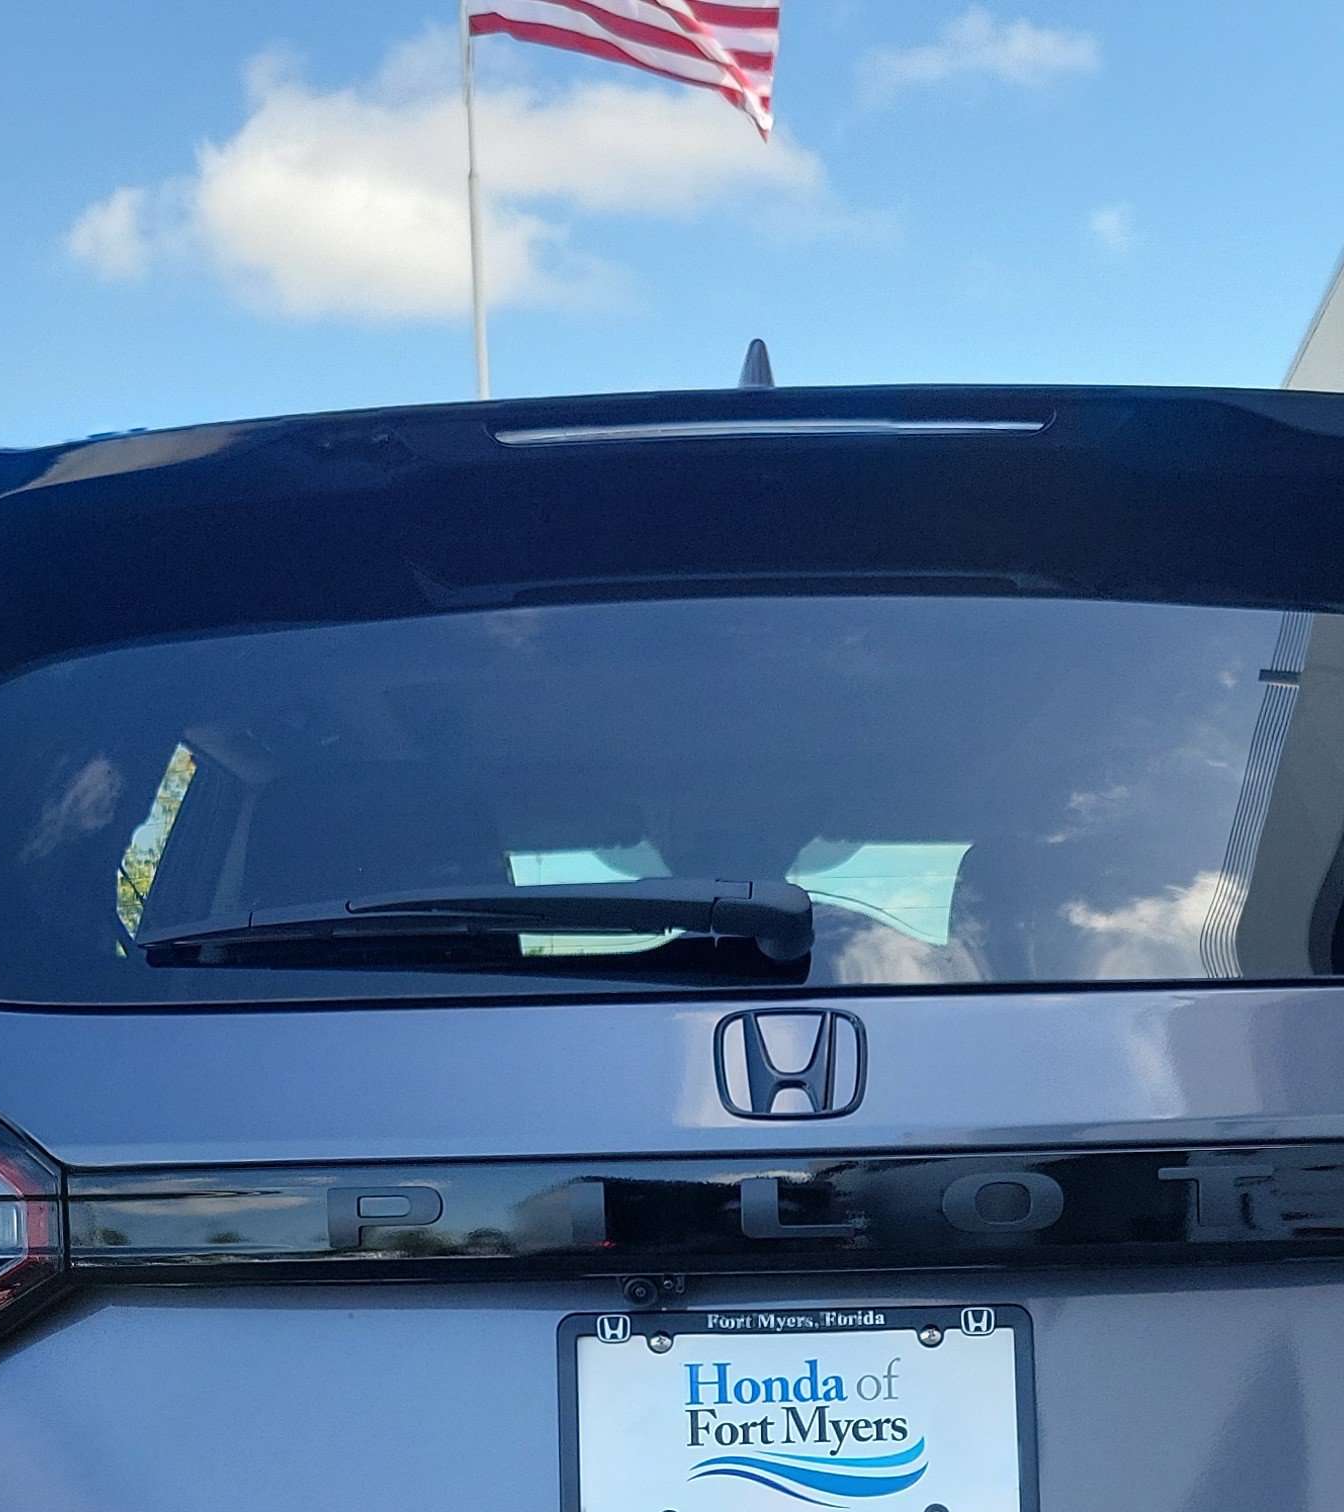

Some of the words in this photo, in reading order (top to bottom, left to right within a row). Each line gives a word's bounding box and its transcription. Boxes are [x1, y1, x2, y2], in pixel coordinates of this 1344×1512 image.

[327, 1165, 1274, 1250] PILOT
[707, 1313, 753, 1330] Fort
[757, 1312, 819, 1332] Myers,
[684, 1359, 848, 1405] Honda
[856, 1357, 901, 1401] of
[685, 1408, 775, 1446] Fort
[781, 1405, 908, 1456] Myers
